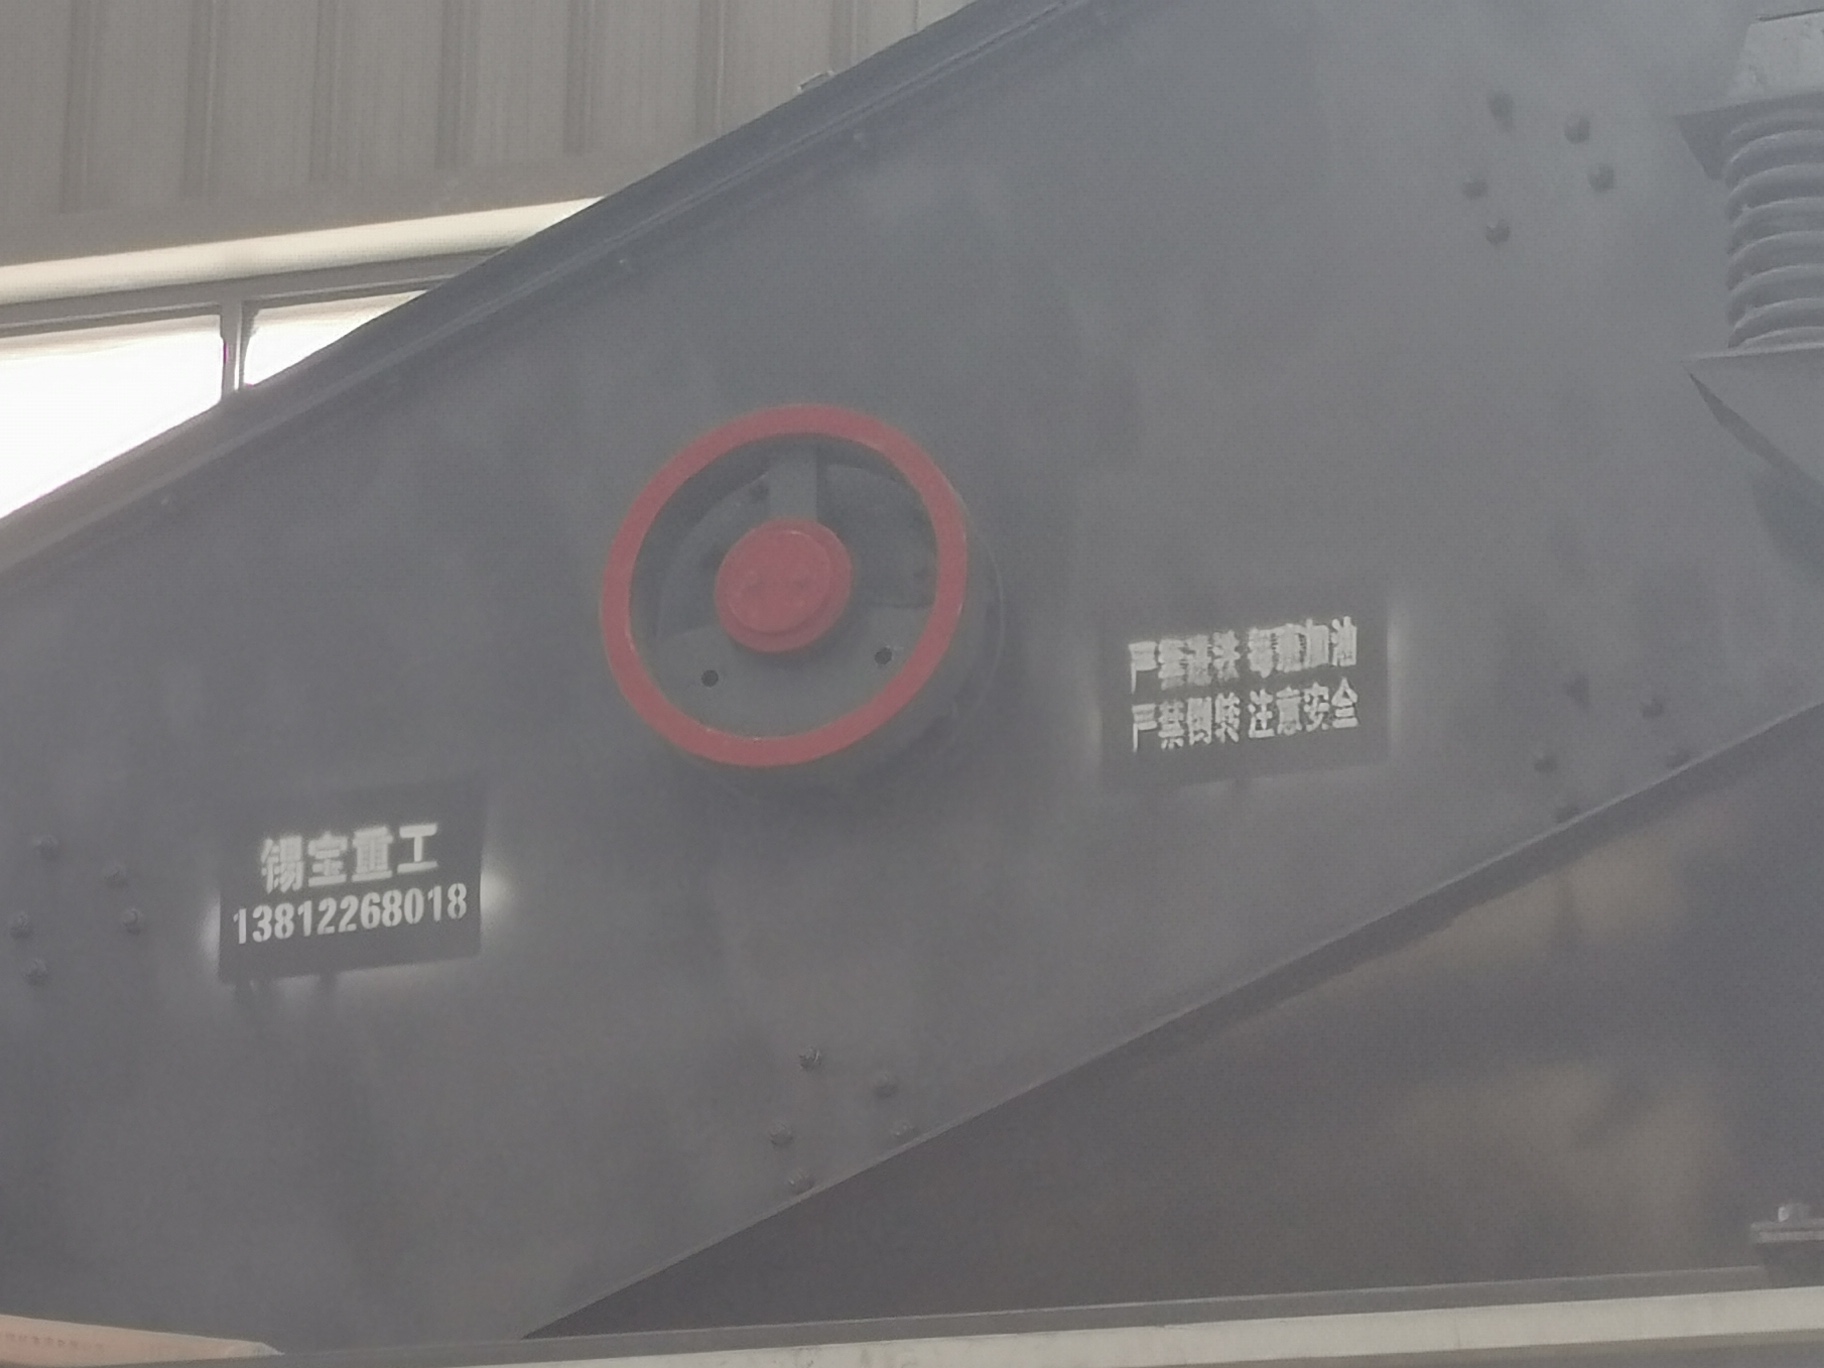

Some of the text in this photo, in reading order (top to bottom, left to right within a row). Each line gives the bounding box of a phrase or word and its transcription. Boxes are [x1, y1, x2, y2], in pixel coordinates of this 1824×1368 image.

[1248, 676, 1359, 738] 注意安全
[261, 822, 439, 895] 锡宝重工
[233, 882, 467, 945] 13812268018
